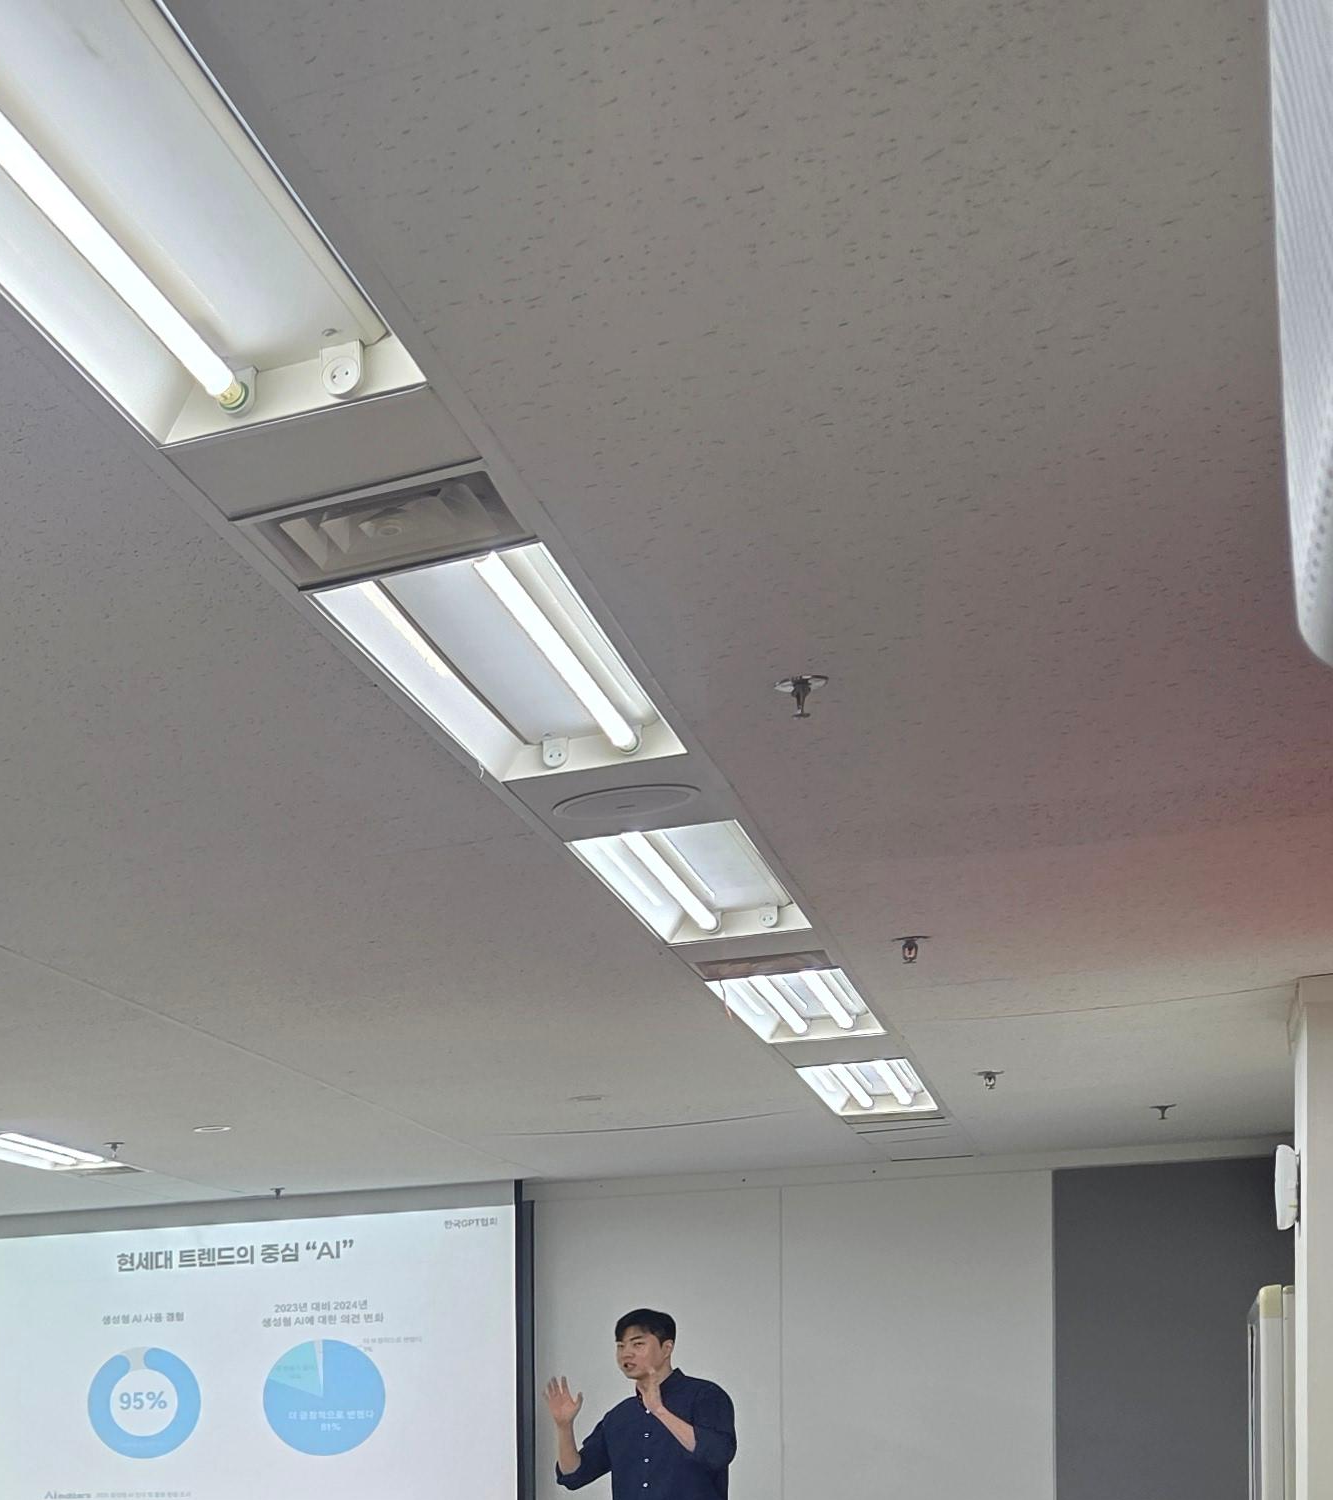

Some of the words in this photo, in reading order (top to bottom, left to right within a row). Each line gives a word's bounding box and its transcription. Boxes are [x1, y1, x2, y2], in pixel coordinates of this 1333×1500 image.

[116, 1250, 173, 1272] 현세대
[178, 1245, 255, 1268] 트렌드의
[260, 1243, 299, 1264] 중심
[274, 1302, 308, 1314] 2023년
[311, 1301, 331, 1312] 대비
[333, 1299, 368, 1310] 2024년
[101, 1314, 130, 1326] 생성형
[132, 1313, 142, 1323] AI
[144, 1312, 162, 1323] 사용
[261, 1316, 292, 1328] 생성형
[294, 1315, 315, 1326] AI에
[317, 1314, 337, 1325] 대한
[340, 1313, 360, 1324] 의견
[364, 1312, 384, 1323] 변화
[119, 1391, 168, 1410] 95%
